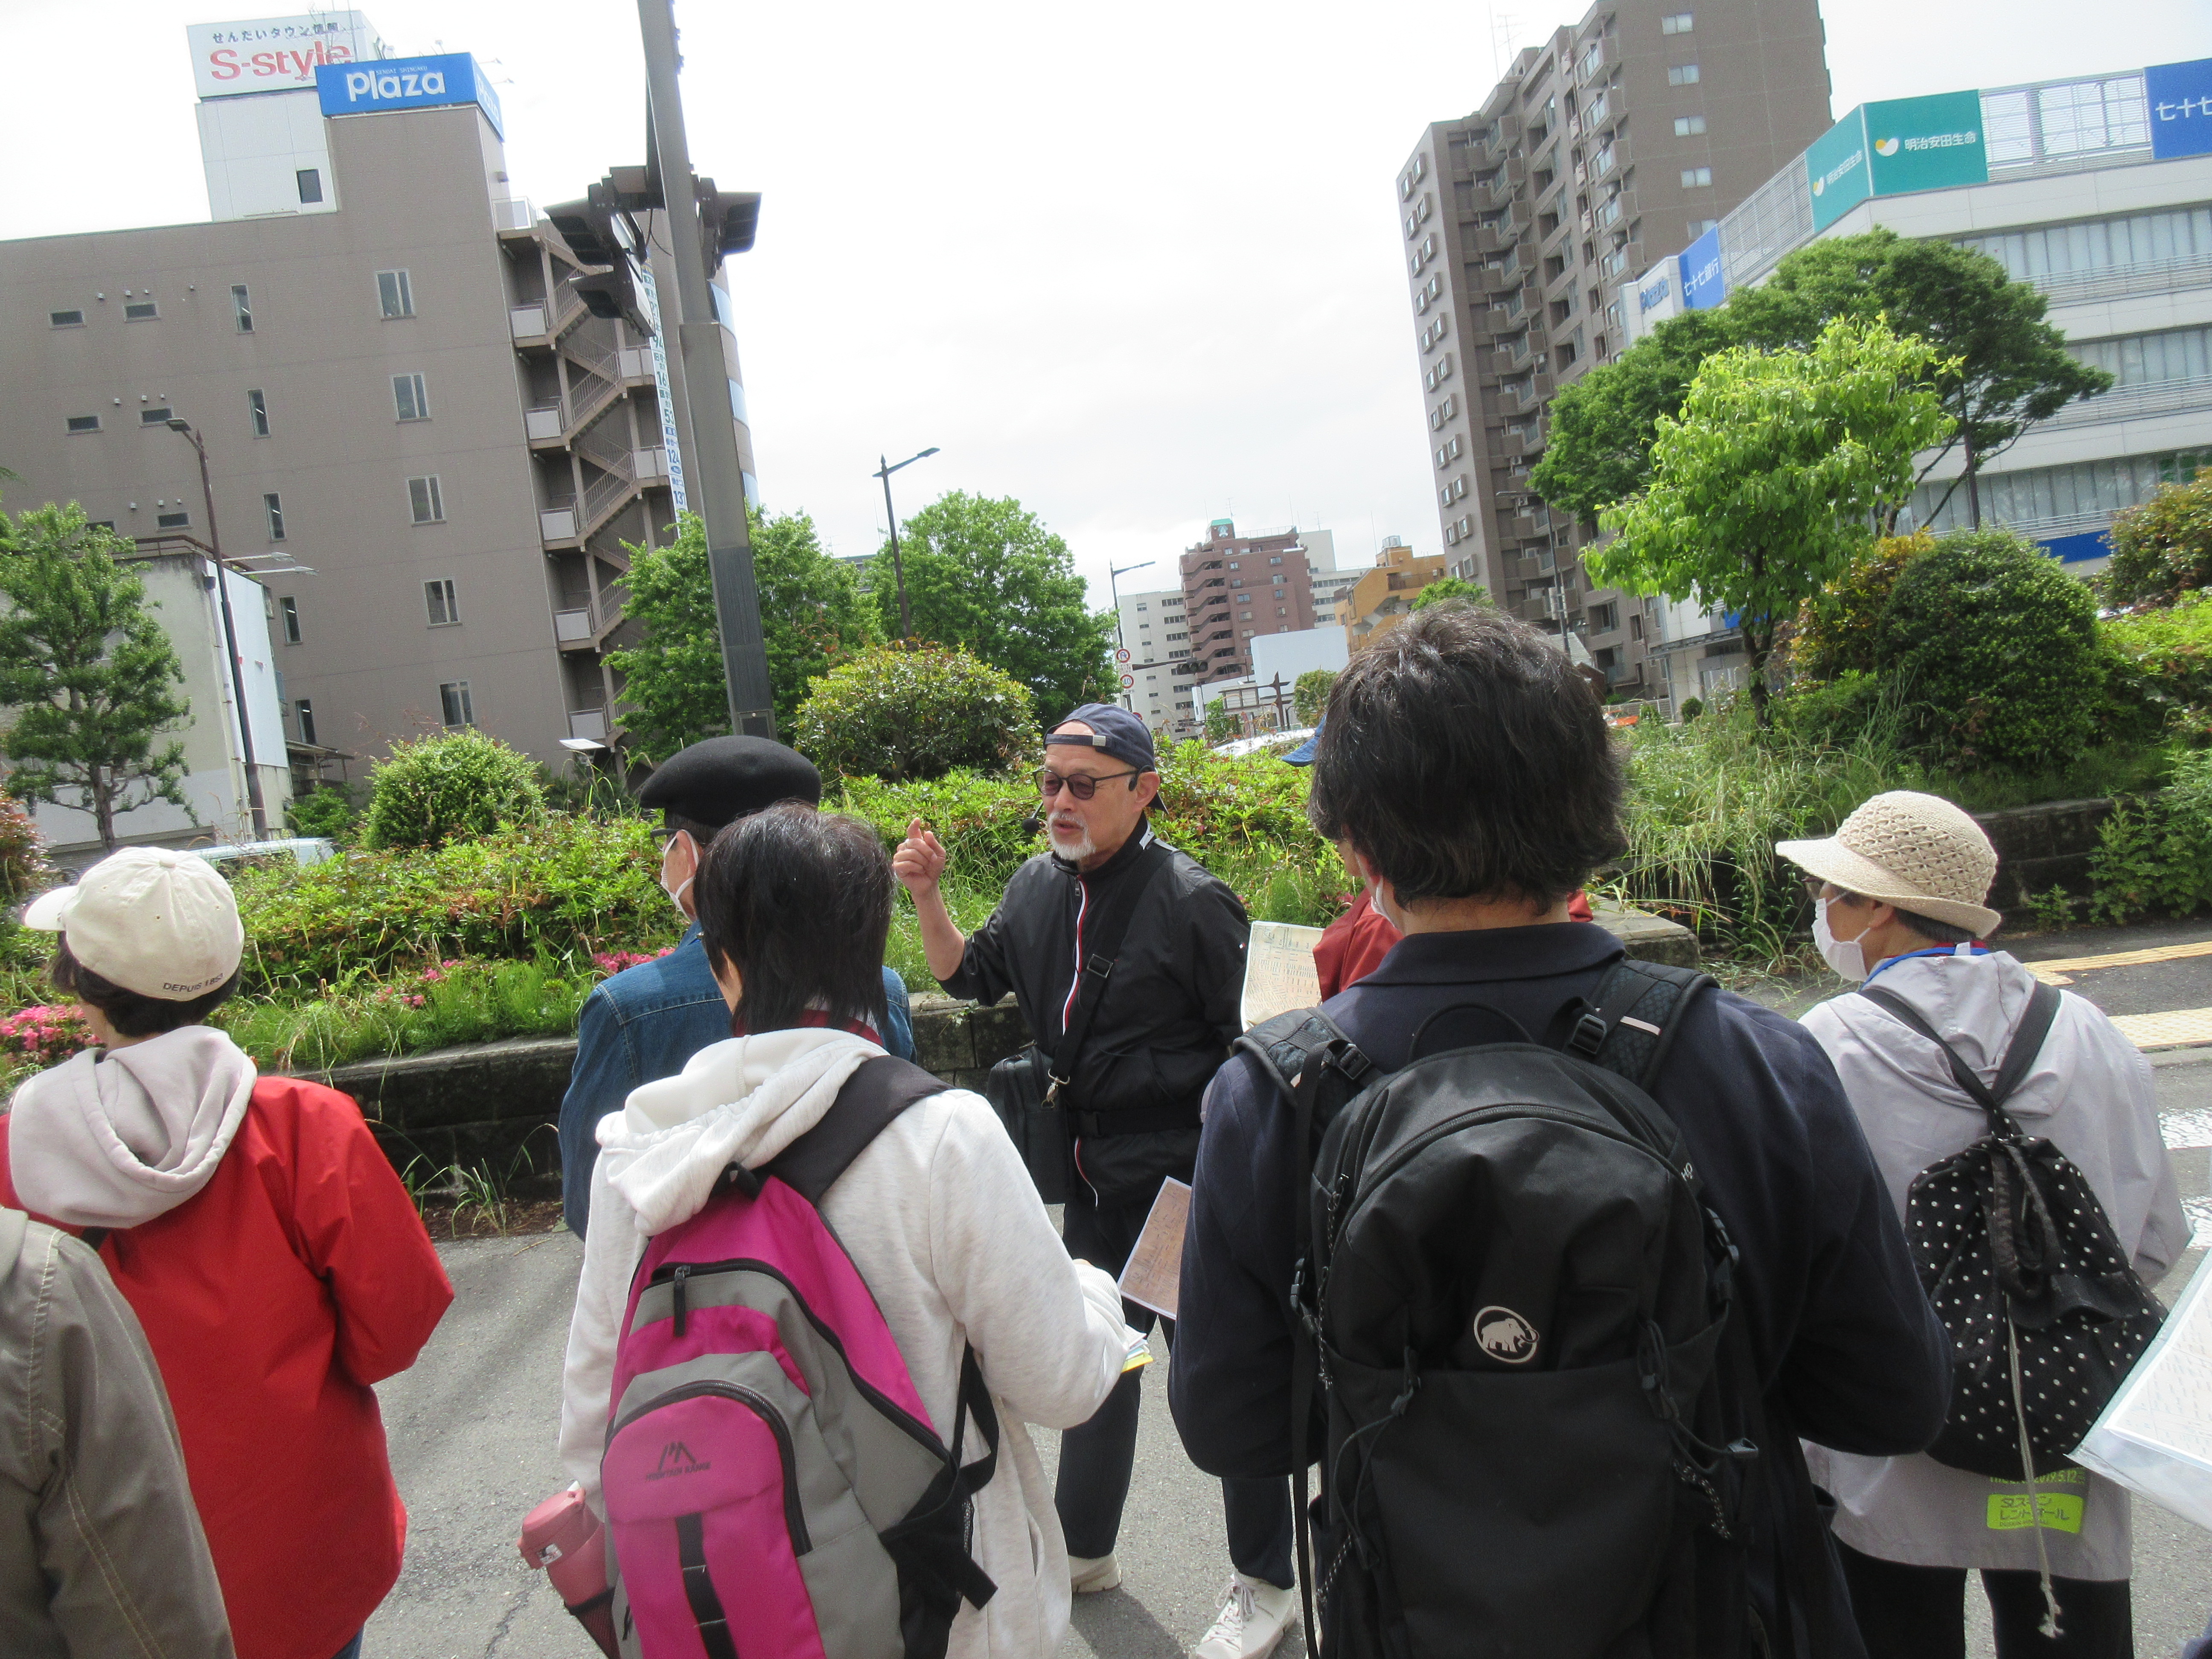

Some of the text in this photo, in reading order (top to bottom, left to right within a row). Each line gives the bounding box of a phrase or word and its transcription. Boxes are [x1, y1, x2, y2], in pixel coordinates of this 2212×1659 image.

[210, 41, 351, 81] S-style
[1905, 131, 1976, 151] 明治安田生命
[1684, 257, 1719, 296] 七十七銀行
[163, 983, 202, 992] DEPUIS
